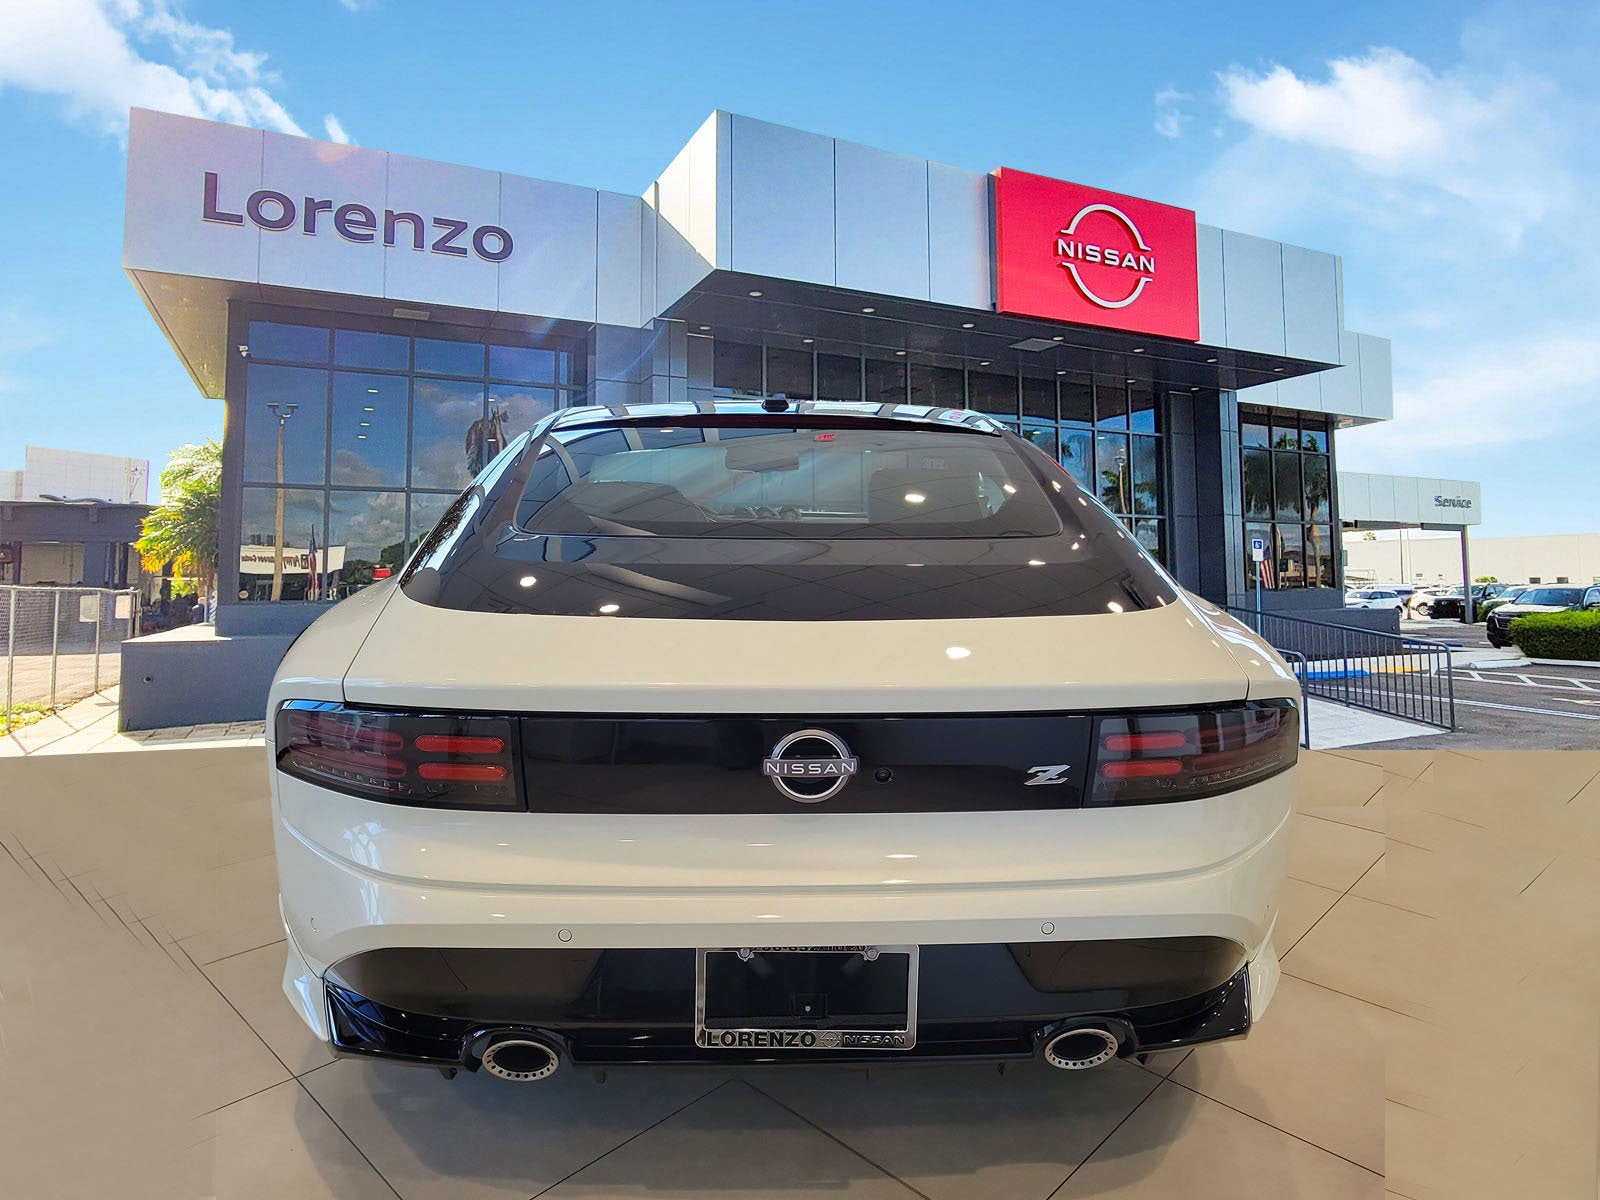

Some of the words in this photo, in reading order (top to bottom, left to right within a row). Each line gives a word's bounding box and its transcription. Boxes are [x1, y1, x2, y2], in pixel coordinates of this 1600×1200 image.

[203, 171, 514, 261] Lorenzo
[1057, 238, 1155, 273] NISSAN
[1434, 495, 1472, 508] Service
[766, 761, 855, 774] NISSAN
[1024, 765, 1071, 786] Z
[706, 1031, 816, 1048] LORENZO
[843, 1034, 905, 1045] NISSAN
